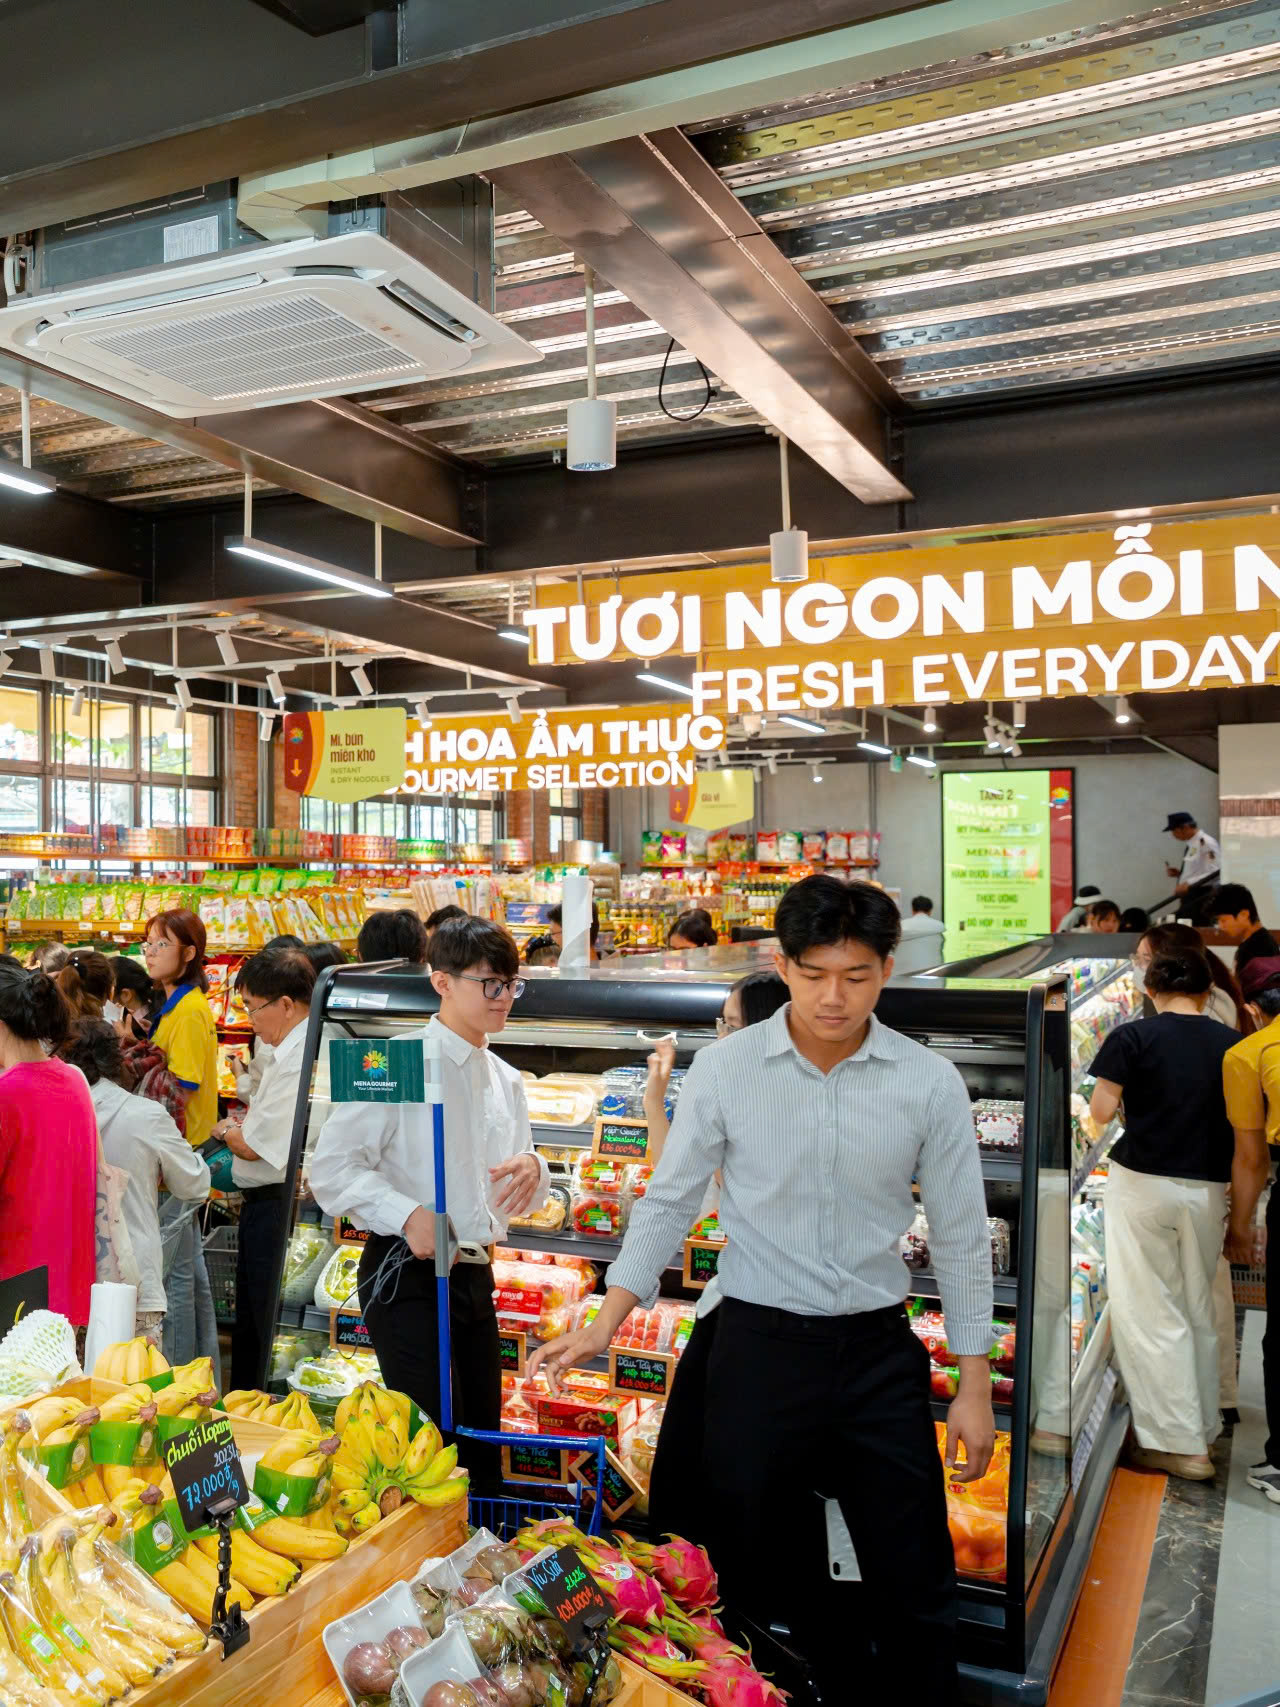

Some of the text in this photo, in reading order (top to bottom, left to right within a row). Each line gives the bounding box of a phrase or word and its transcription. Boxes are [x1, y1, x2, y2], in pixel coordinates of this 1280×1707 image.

[523, 594, 701, 664] TƯƠI
[726, 571, 985, 650] NGON
[1012, 523, 1204, 629] MỖI
[693, 631, 1280, 717] FRESH EVERYDAY
[430, 727, 517, 763] HOA
[525, 709, 593, 759] ẨM
[330, 766, 361, 774] INSTANT
[353, 775, 391, 783] NOODLES
[384, 760, 694, 794] OURMET SELECTION
